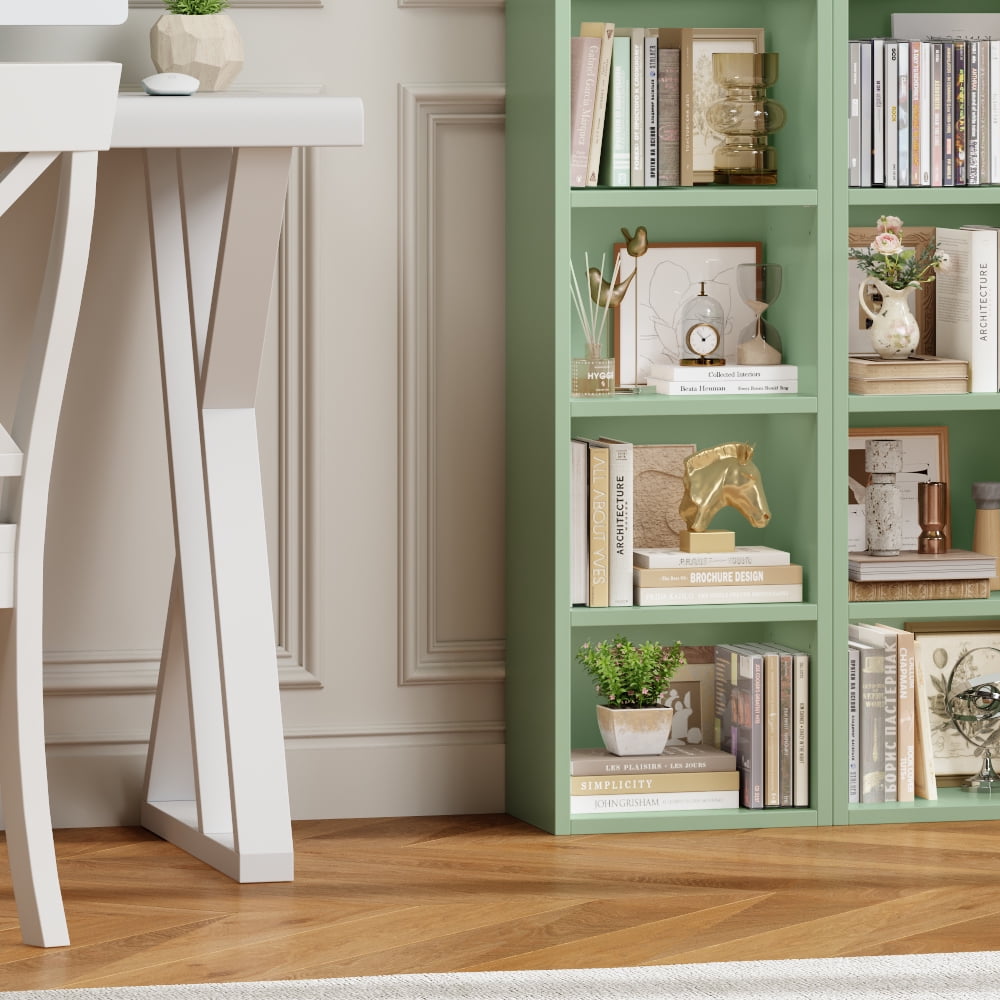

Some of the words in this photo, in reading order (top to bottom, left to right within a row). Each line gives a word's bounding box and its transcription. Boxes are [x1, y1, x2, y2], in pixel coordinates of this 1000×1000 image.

[588, 45, 599, 77] Gabriel
[979, 263, 988, 342] ARCHITECTURE
[680, 384, 697, 392] Beata
[708, 370, 735, 378] Collected
[736, 370, 761, 378] Interiors
[593, 456, 606, 484] ALL
[592, 489, 608, 541] ABOUT
[616, 475, 625, 555] ARCHITECTURE
[592, 547, 607, 585] YVES
[690, 572, 733, 584] BROCHURE
[735, 571, 764, 583] DESIGN
[884, 642, 897, 736] ПАСТЕРНАК
[899, 647, 907, 699] CHAPMAN
[624, 763, 662, 771] PLAISIRS
[884, 740, 897, 793] БОРИС
[580, 780, 654, 791] SIMPLICITY
[594, 799, 619, 809] JOHN
[619, 798, 660, 808] GRISHAM
